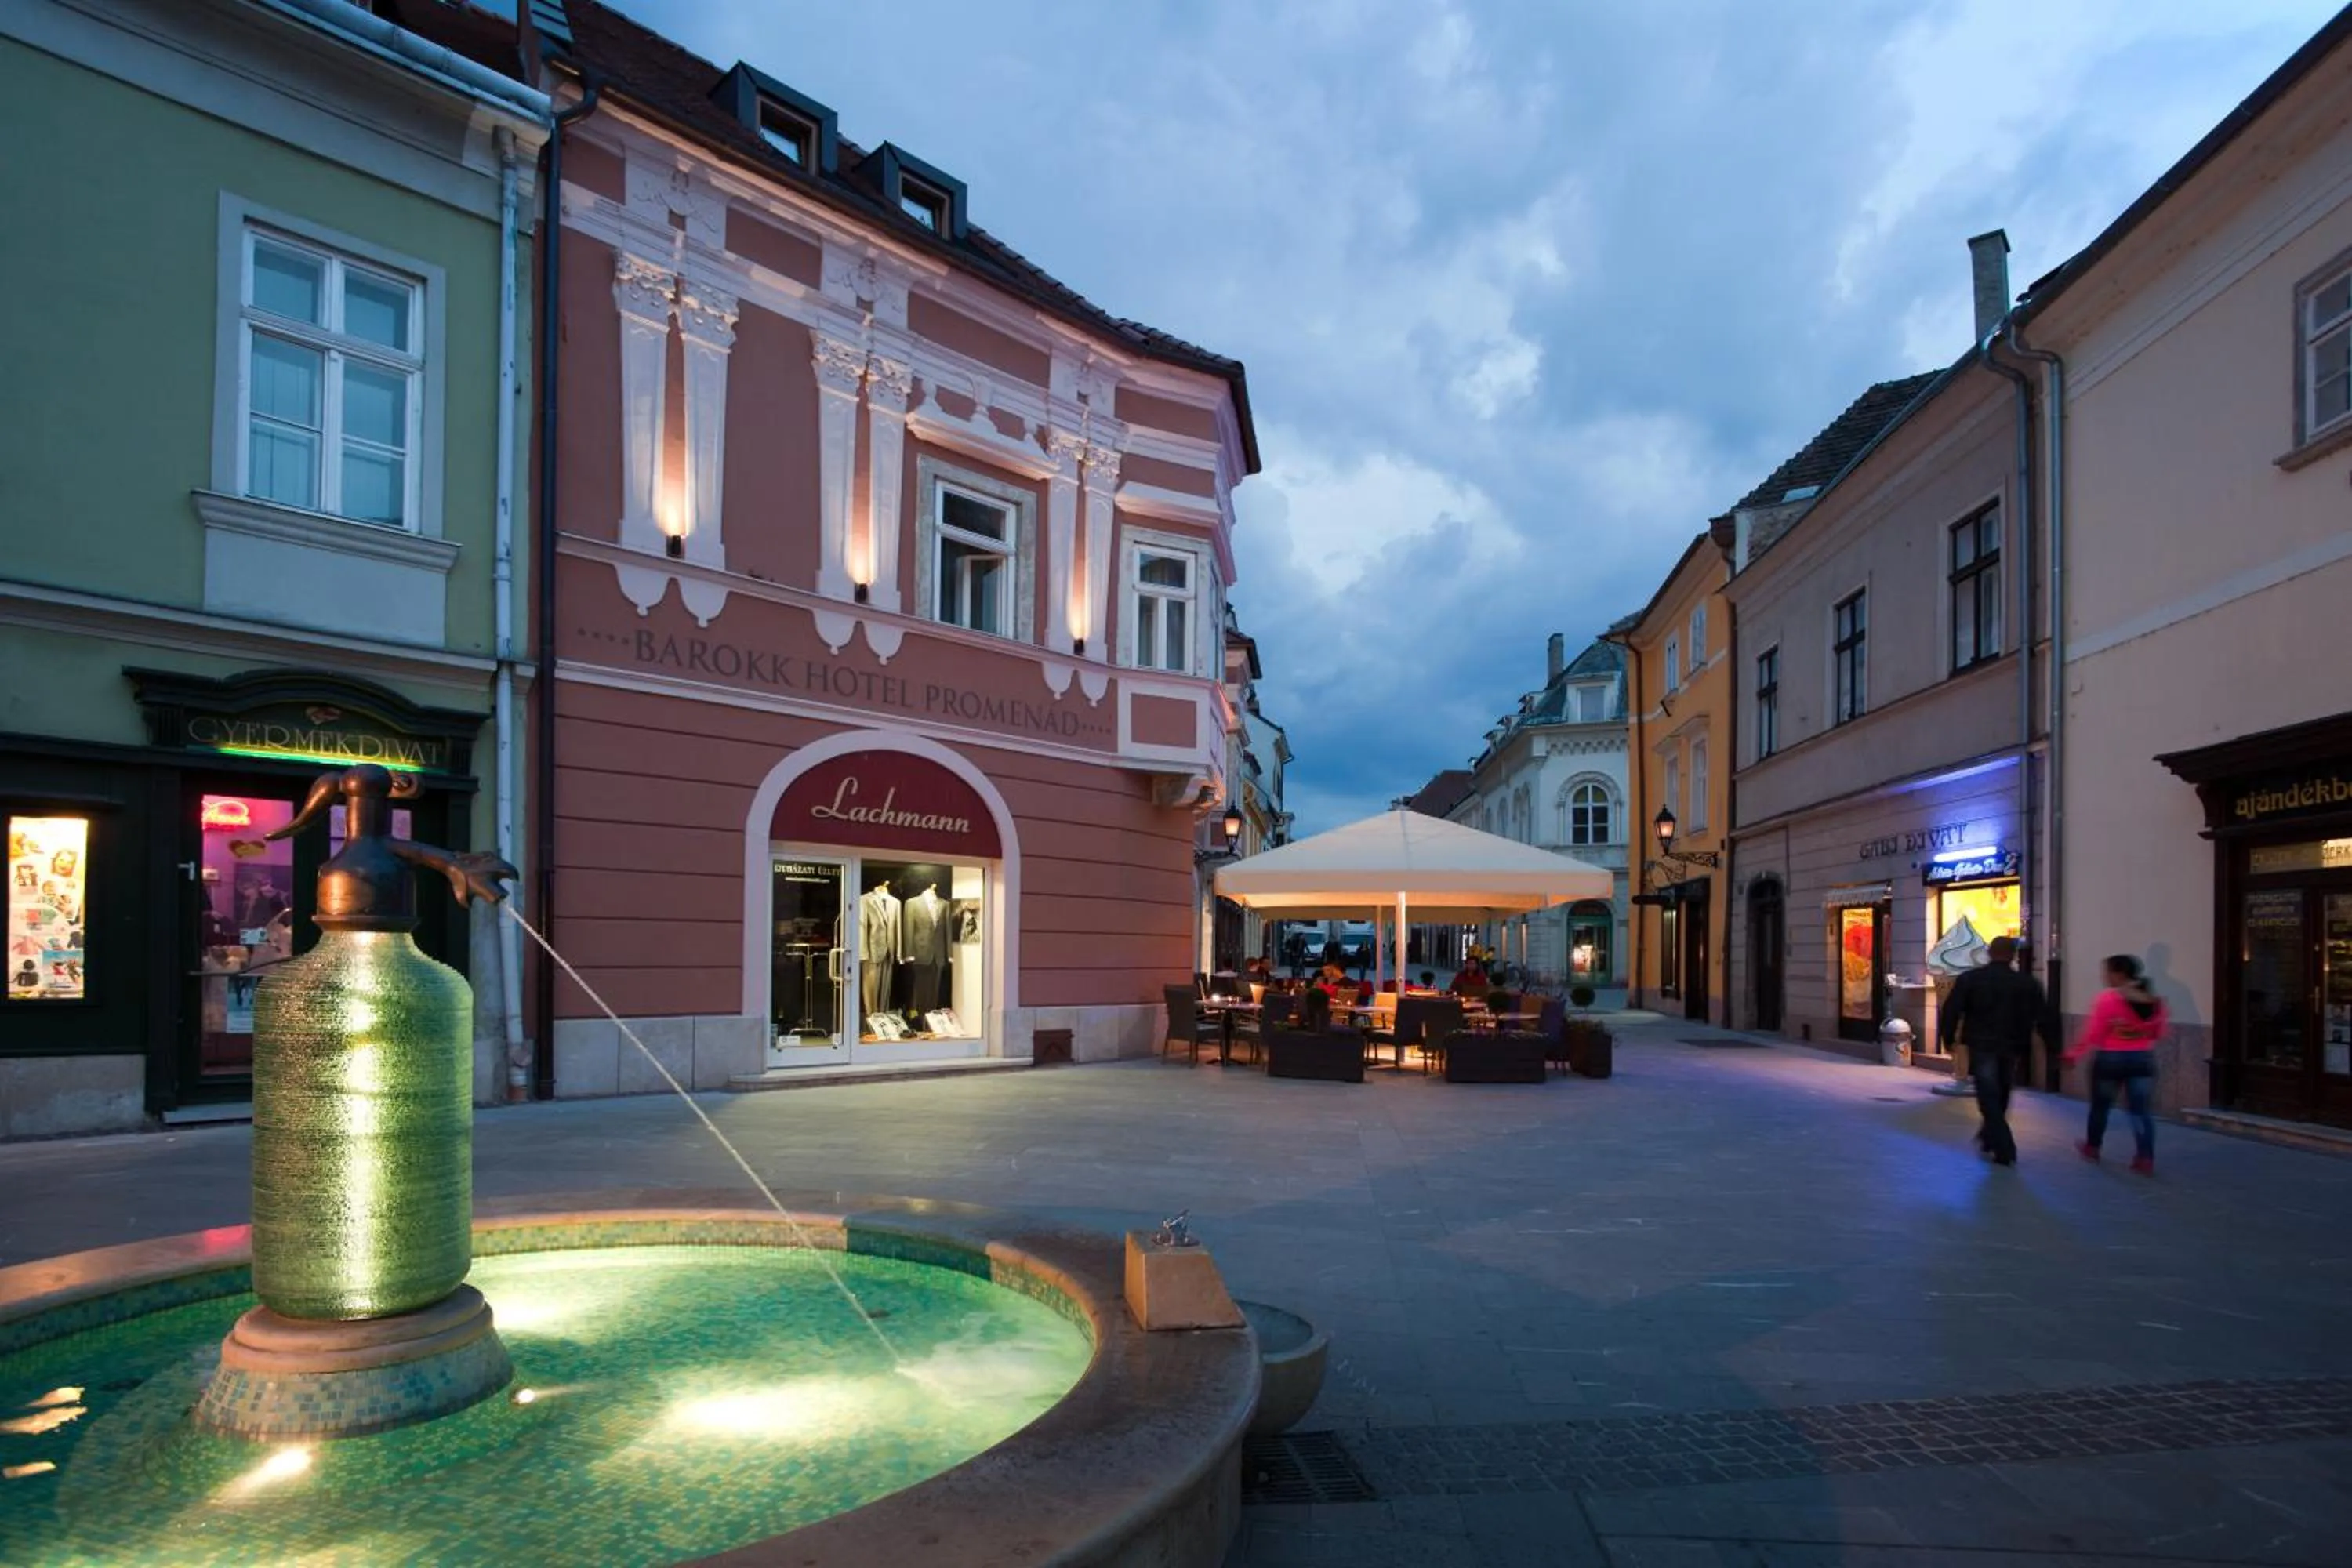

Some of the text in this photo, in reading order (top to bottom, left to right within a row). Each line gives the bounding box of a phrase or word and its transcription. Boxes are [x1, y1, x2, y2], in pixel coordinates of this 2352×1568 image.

[634, 629, 1080, 737] BAROKK HOTEL PROMENÁD
[188, 717, 442, 764] GYERMEKDIVAT
[811, 776, 971, 833] Lachmann
[1904, 822, 1967, 853] DIVAT
